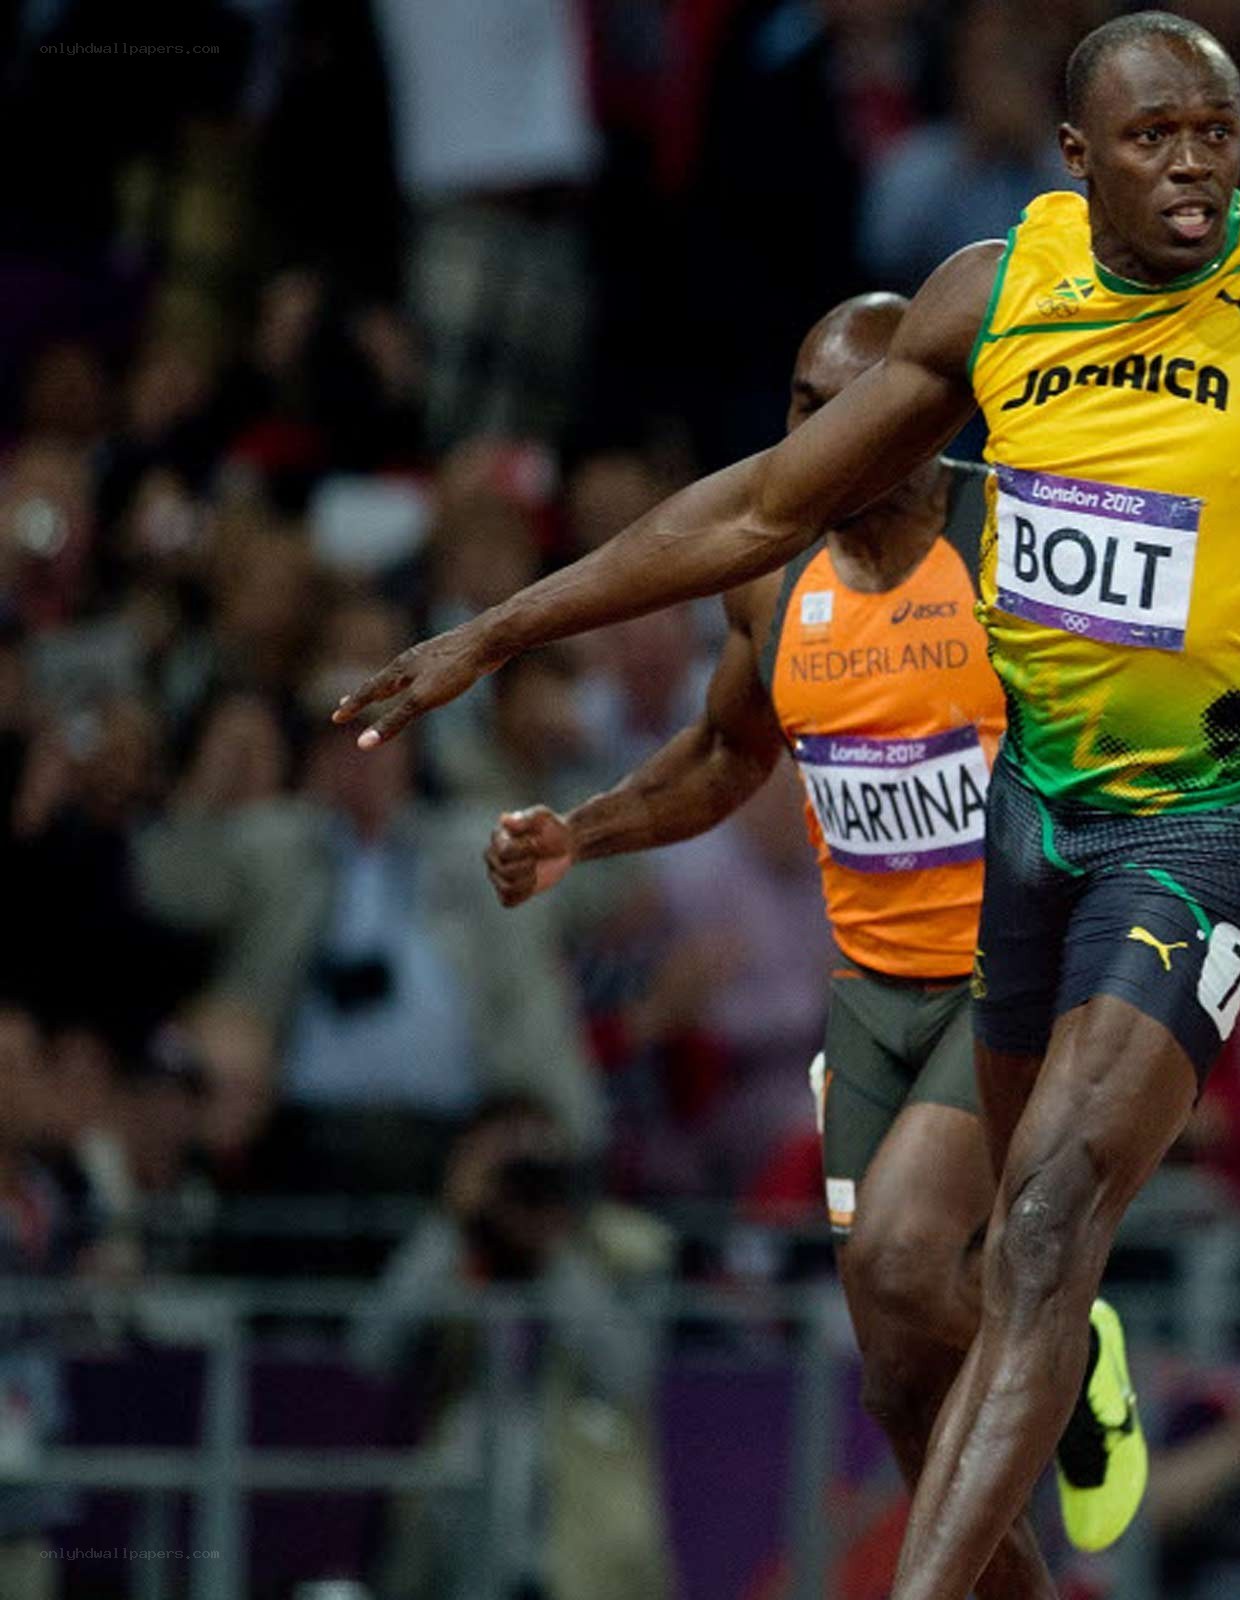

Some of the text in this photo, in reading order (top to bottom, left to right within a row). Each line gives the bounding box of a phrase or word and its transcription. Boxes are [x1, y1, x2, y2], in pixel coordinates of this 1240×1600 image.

[1001, 353, 1230, 412] JAMAICA
[1032, 478, 1146, 516] London 2012
[1014, 516, 1173, 610] BOLT
[789, 638, 969, 683] NEDERLAND
[830, 741, 926, 763] London 2012
[810, 764, 986, 843] MARTINA
